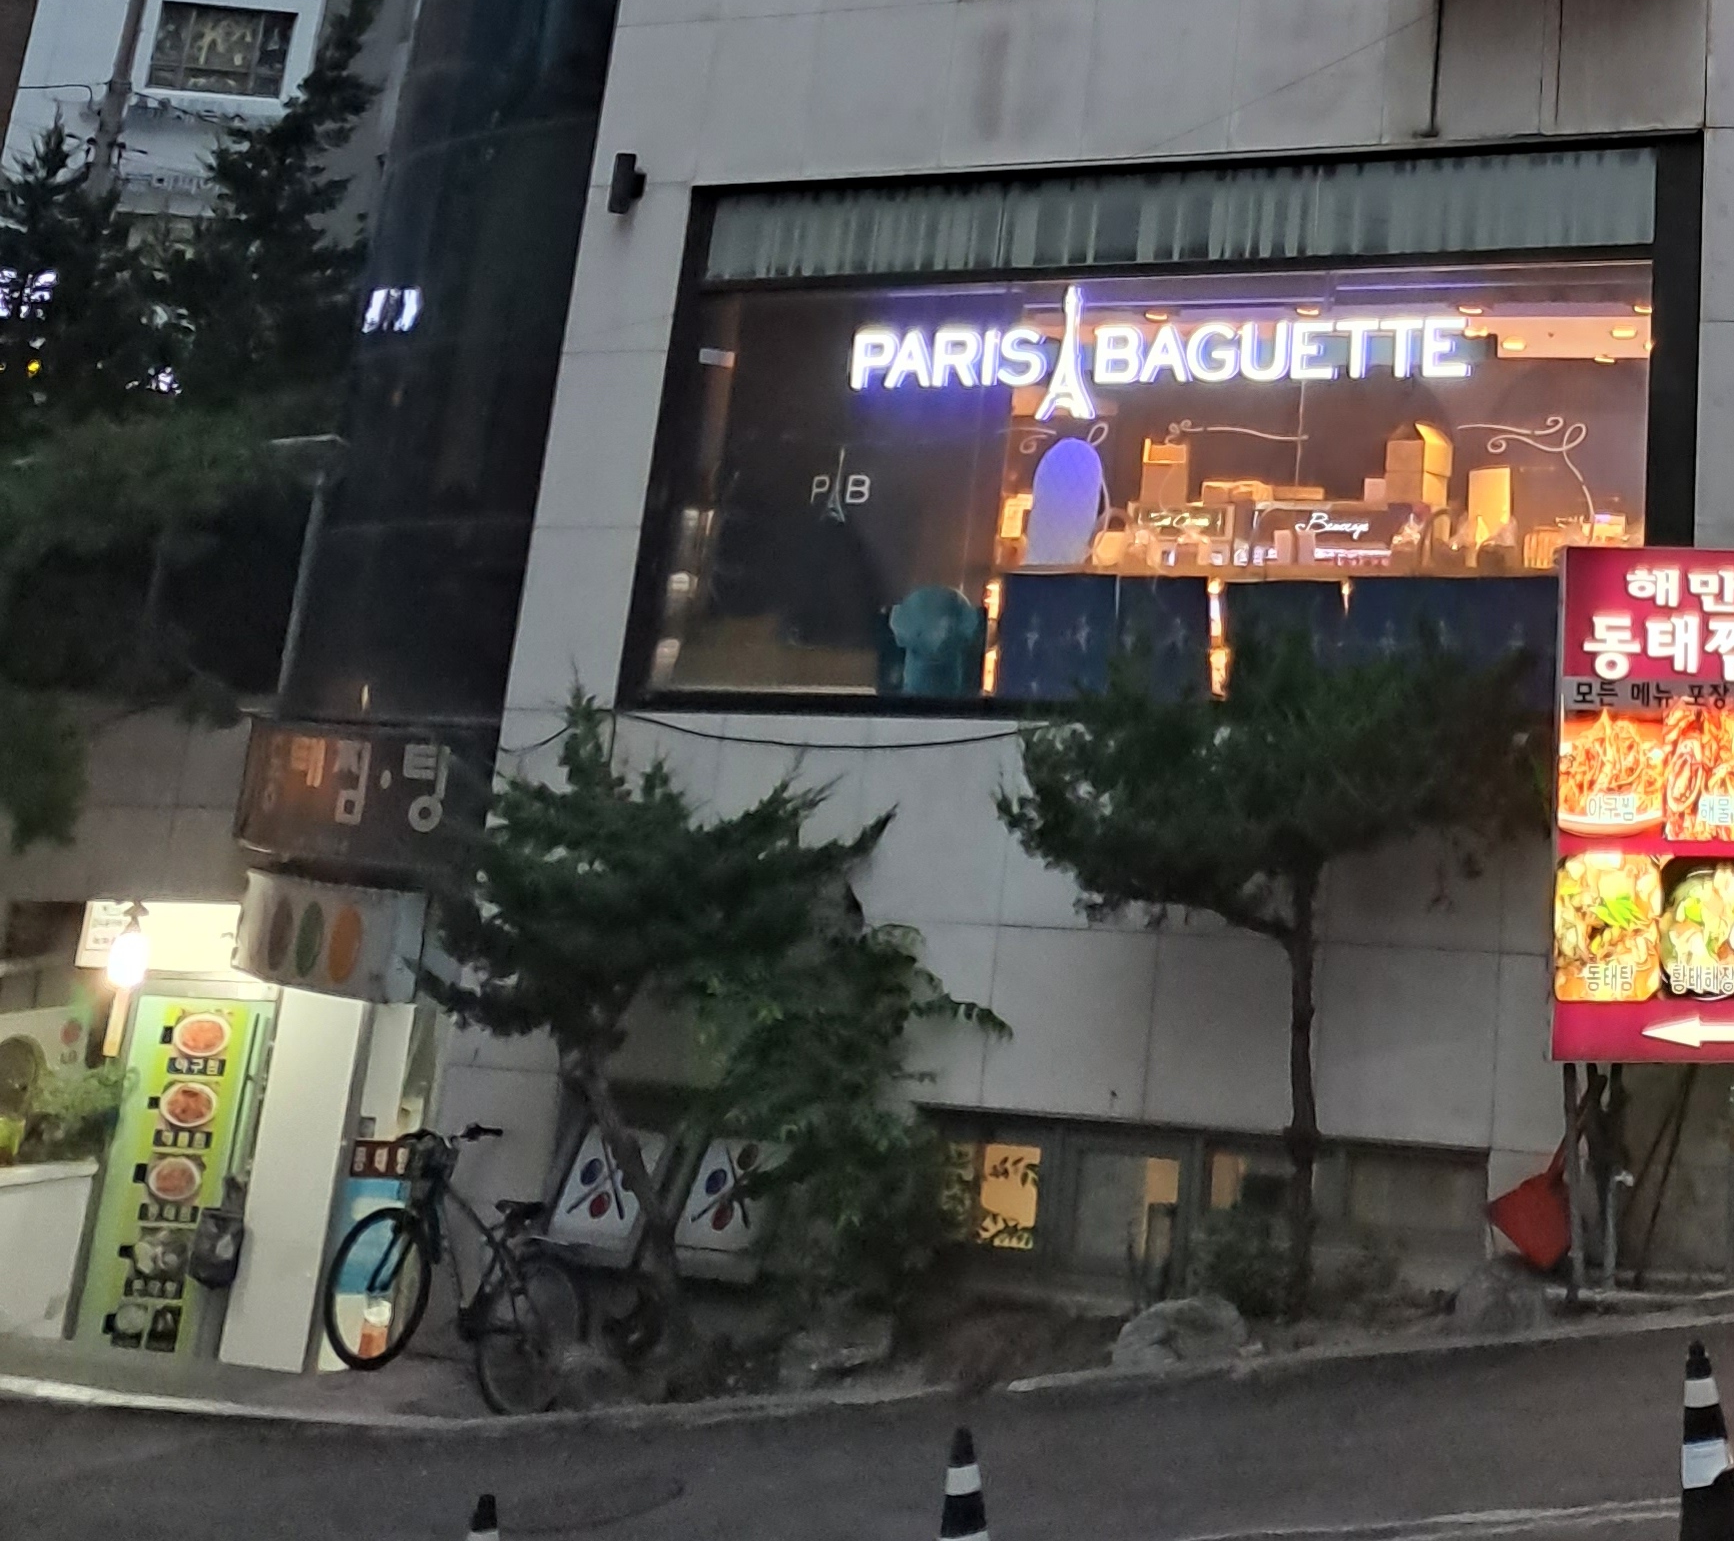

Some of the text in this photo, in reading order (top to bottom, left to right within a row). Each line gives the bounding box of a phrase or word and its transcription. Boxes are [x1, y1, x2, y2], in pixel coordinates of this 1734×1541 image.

[850, 317, 1471, 390] PARIS BAGUETTE
[1574, 683, 1619, 706] 모든
[1631, 683, 1673, 707] 메뉴
[1688, 684, 1729, 708] 포장
